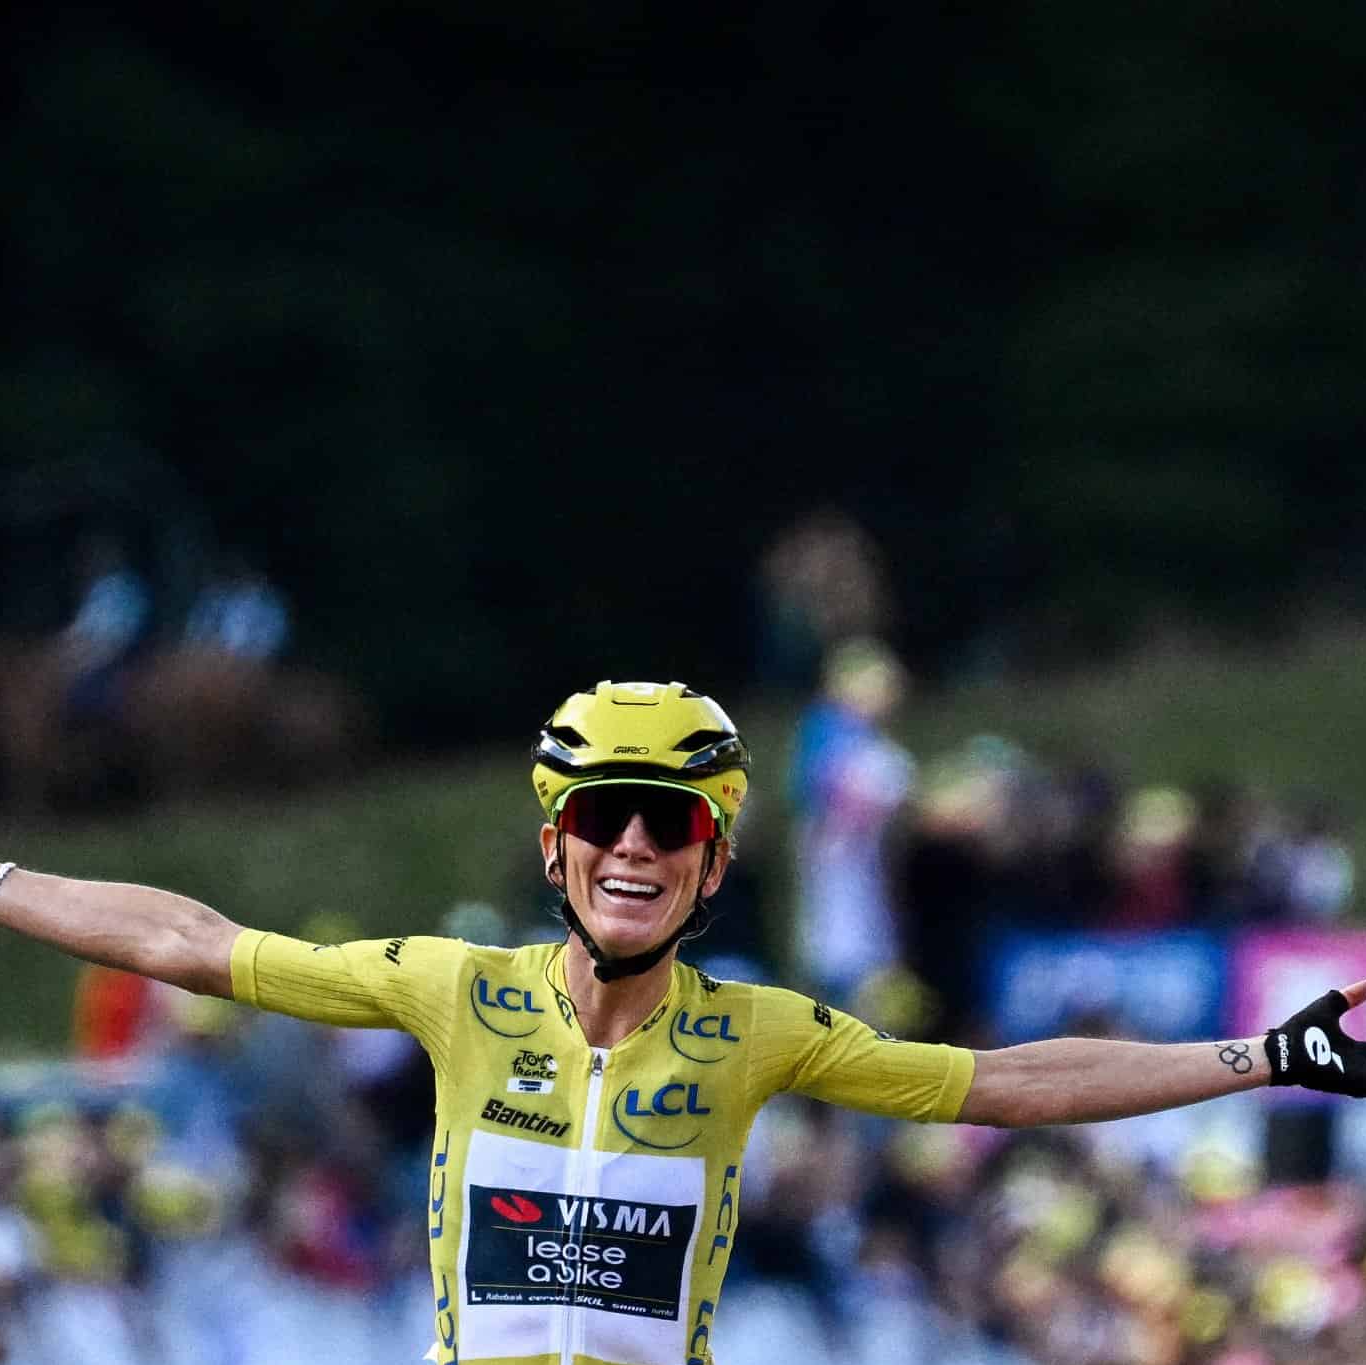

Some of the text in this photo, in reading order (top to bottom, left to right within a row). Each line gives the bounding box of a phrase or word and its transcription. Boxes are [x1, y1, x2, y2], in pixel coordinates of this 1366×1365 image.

[478, 978, 544, 1013] LCL
[677, 1011, 740, 1043] LCL
[481, 1098, 571, 1138] Santini
[625, 1082, 711, 1117] LCL
[430, 1129, 450, 1239] LCL
[557, 1199, 671, 1238] VISMA
[707, 1164, 738, 1266] LCL
[527, 1235, 627, 1265] lease
